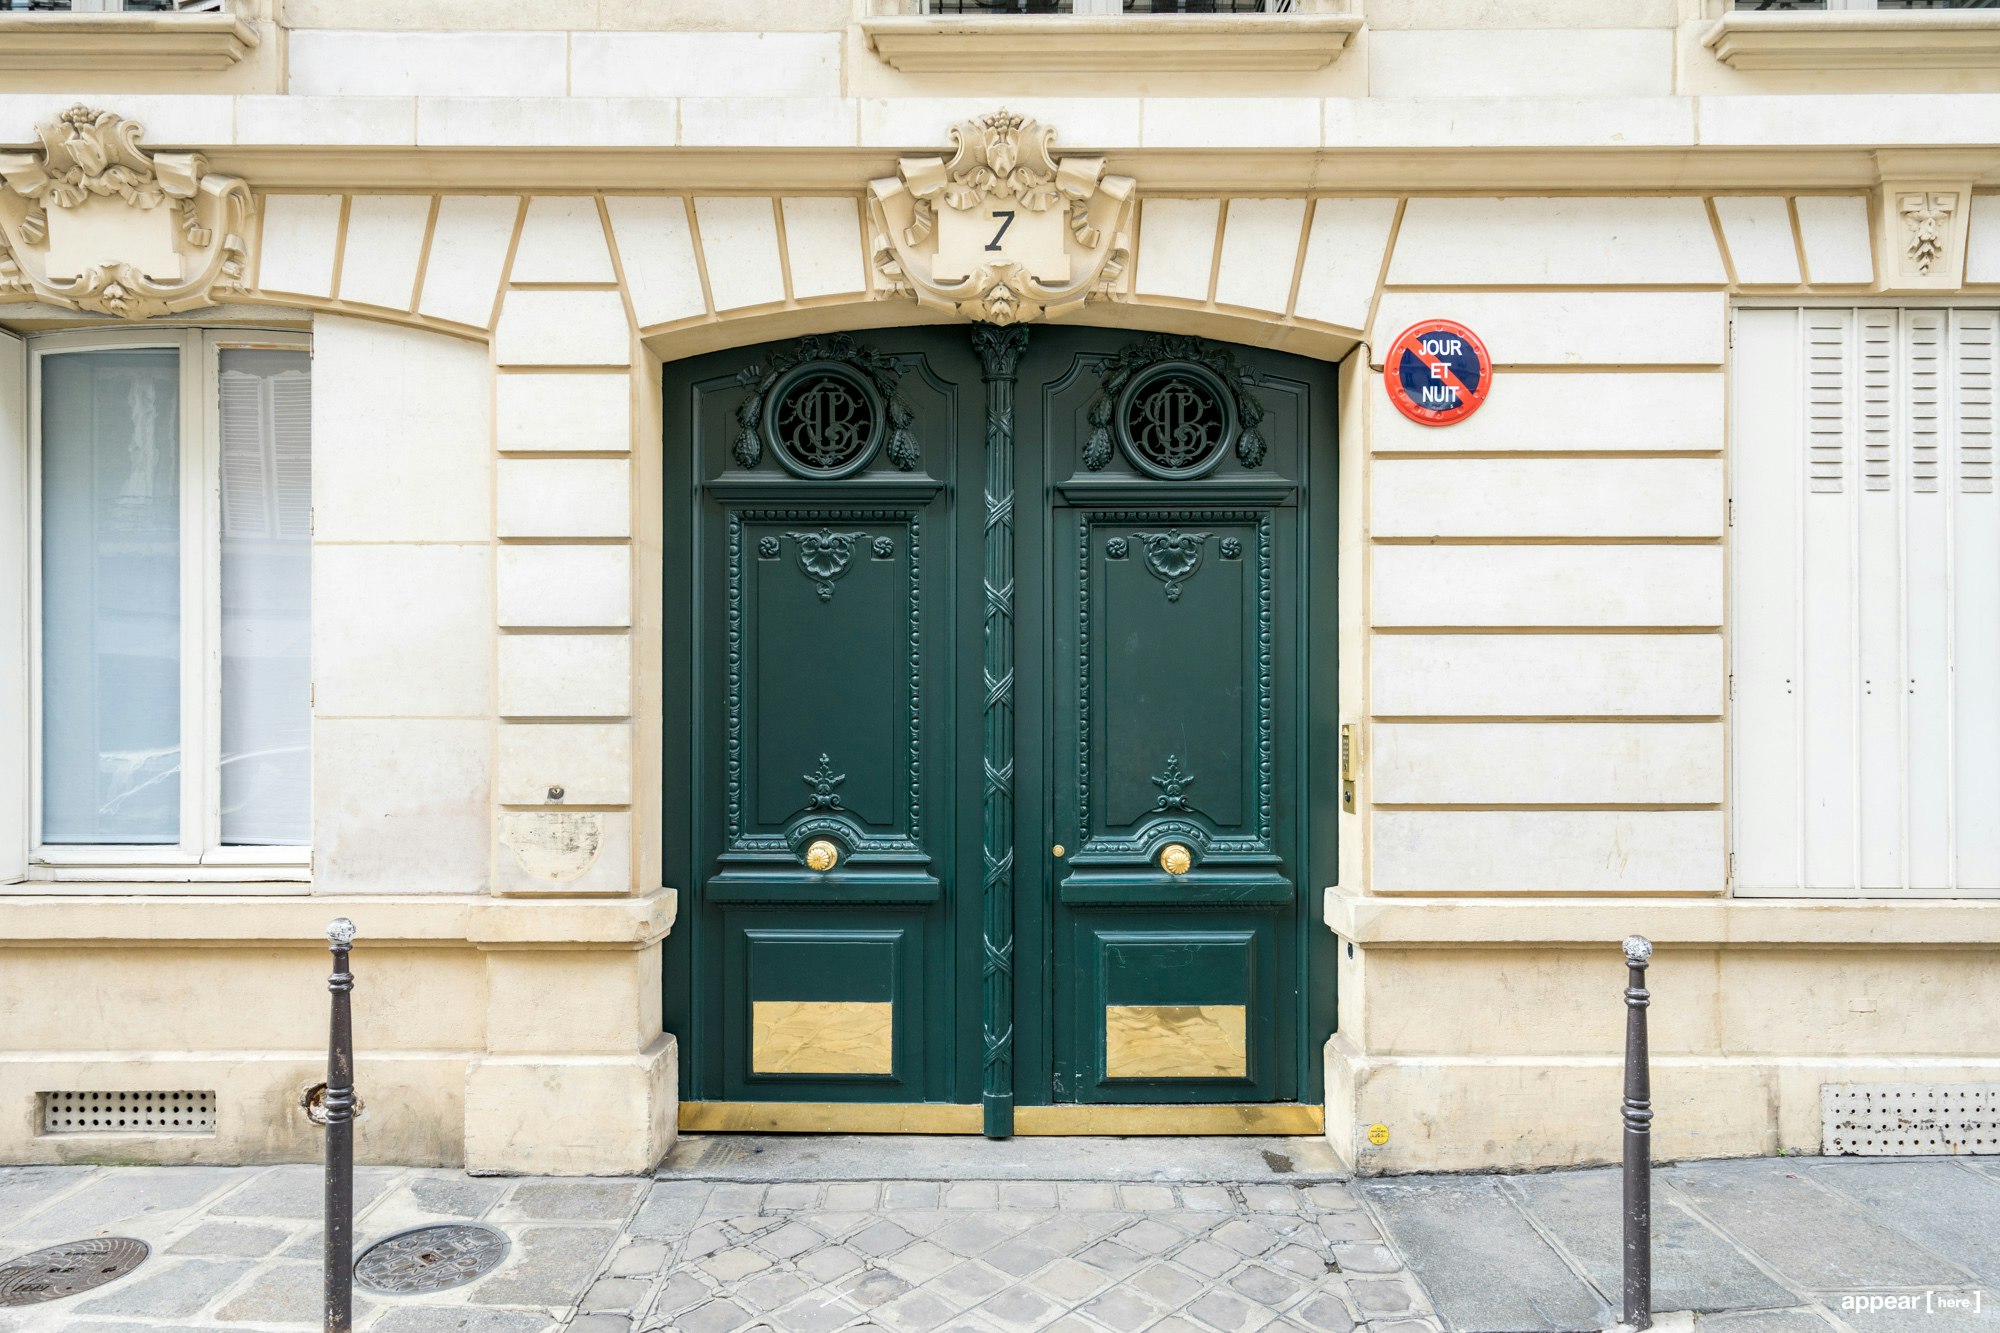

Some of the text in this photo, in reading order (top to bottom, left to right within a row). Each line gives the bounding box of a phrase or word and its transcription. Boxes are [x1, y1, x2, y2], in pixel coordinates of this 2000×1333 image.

[985, 211, 1015, 251] 7
[1419, 340, 1462, 355] JOUR
[1431, 363, 1452, 378] ET
[1423, 386, 1459, 402] NUIT
